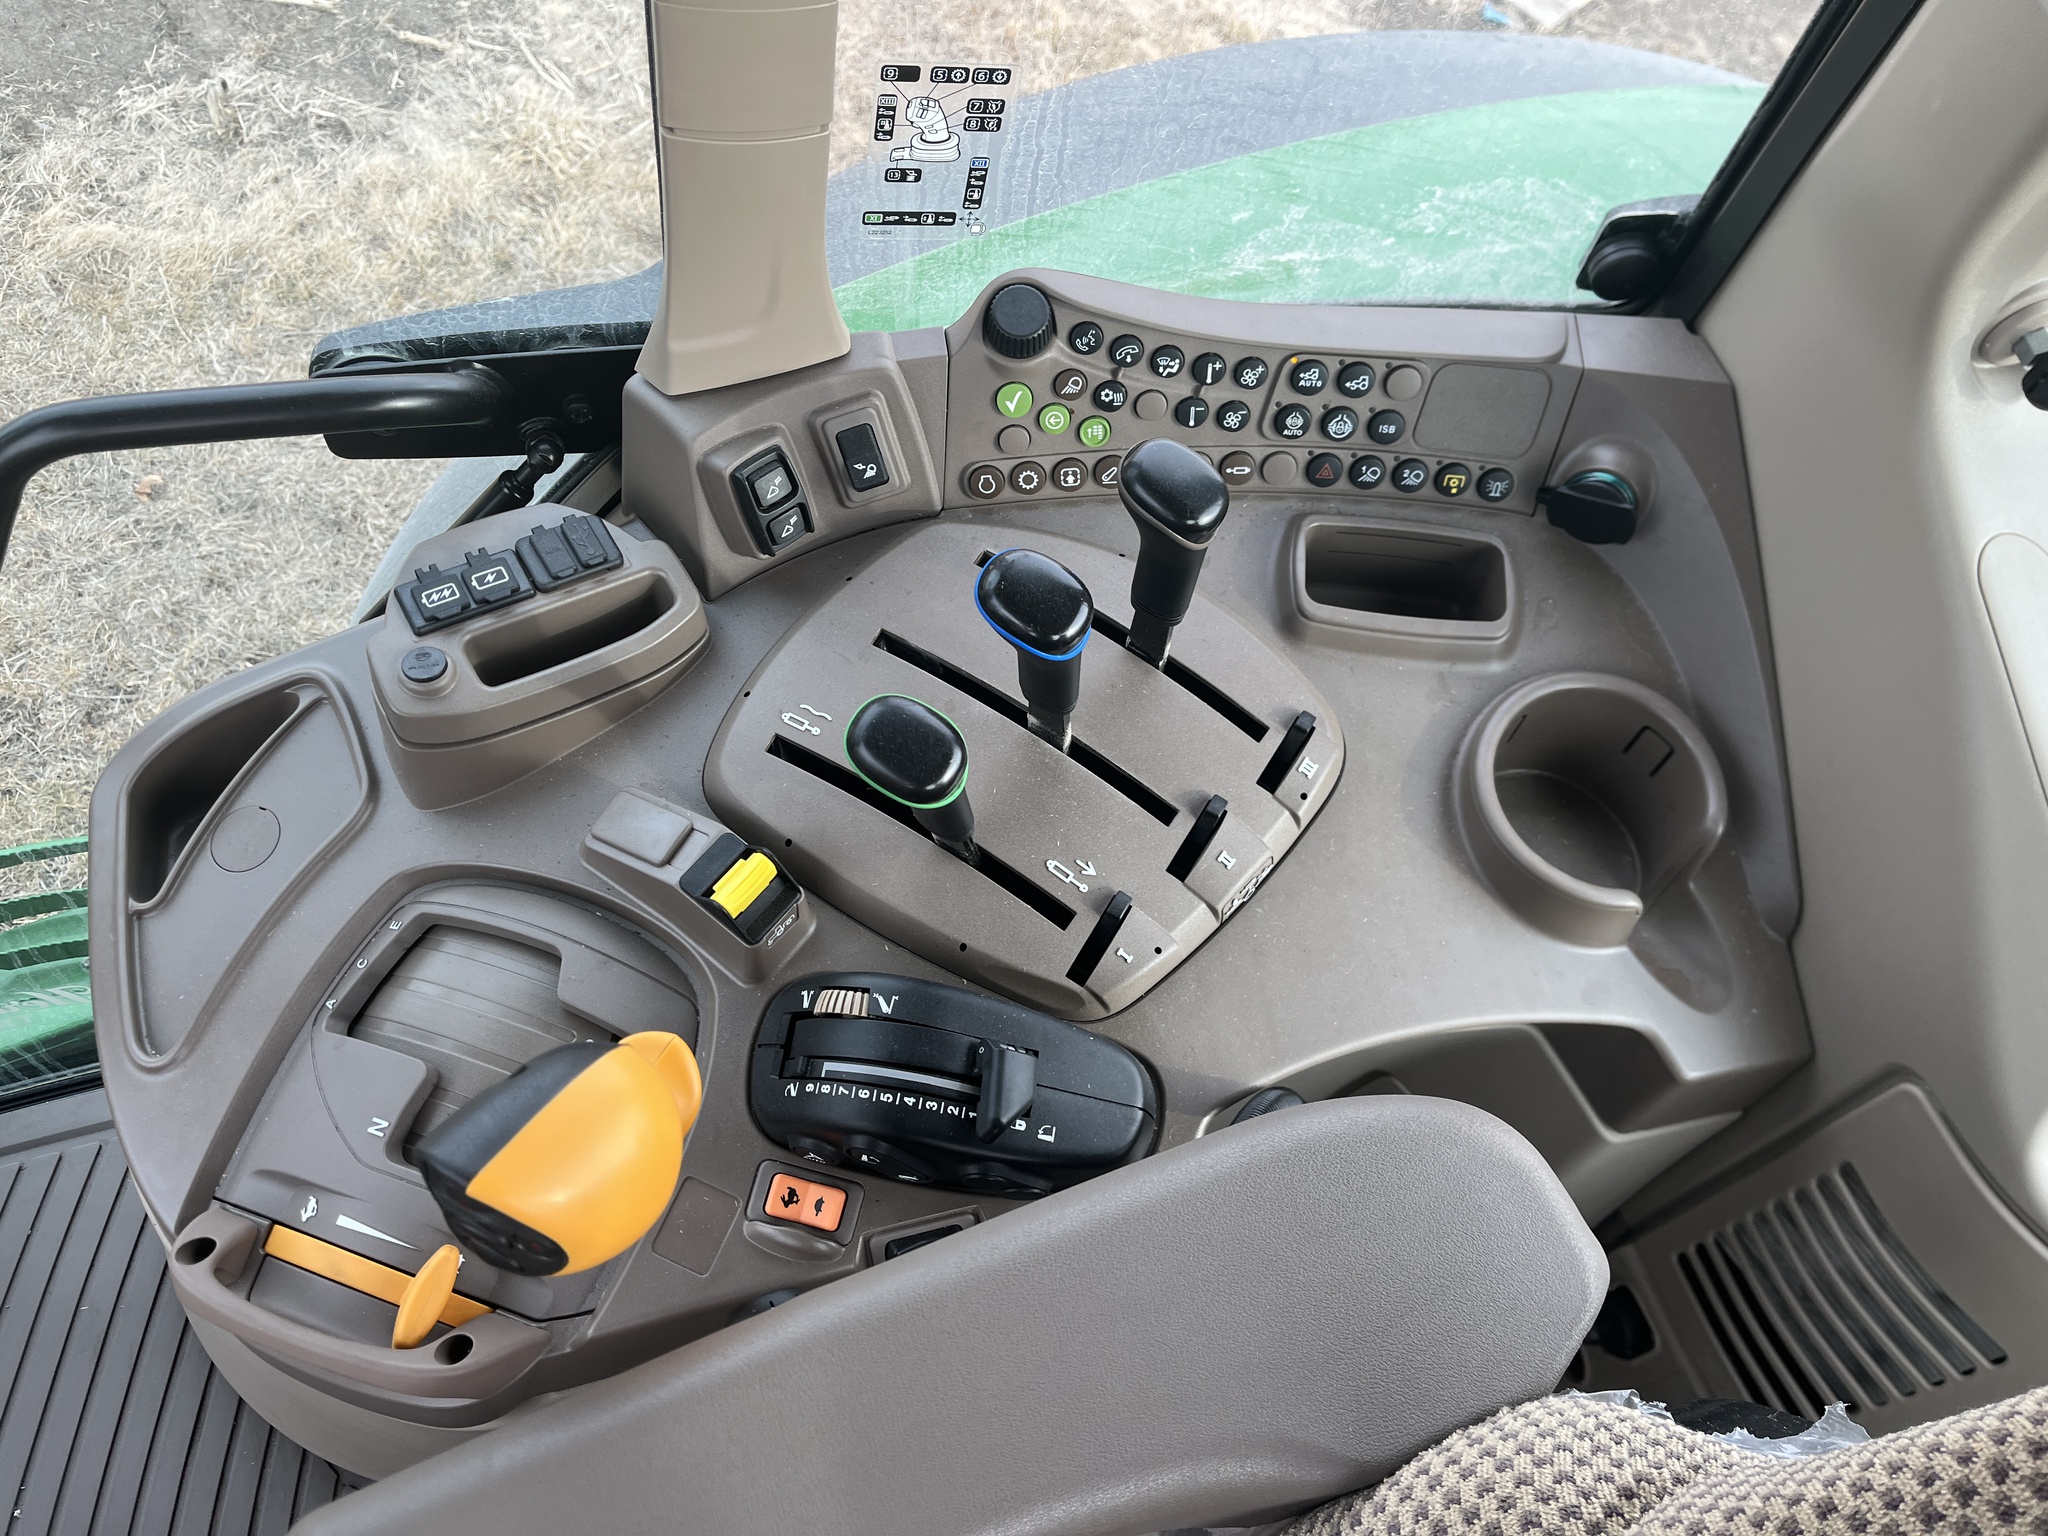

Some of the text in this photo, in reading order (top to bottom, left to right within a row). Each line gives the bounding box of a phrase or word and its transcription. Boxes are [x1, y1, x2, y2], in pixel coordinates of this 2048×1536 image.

[886, 69, 895, 79] 9
[936, 71, 944, 80] 5
[978, 72, 986, 81] 6
[973, 102, 980, 111] 7
[969, 119, 977, 128] 8
[1298, 380, 1323, 388] AUTO
[1378, 425, 1396, 434] ISB
[1361, 465, 1367, 474] 1
[1402, 469, 1410, 478] 2
[1298, 757, 1319, 779] III
[1216, 850, 1237, 870] II
[389, 920, 402, 931] E
[356, 958, 368, 970] C
[325, 998, 338, 1010] A
[805, 1085, 814, 1093] 9
[820, 1084, 831, 1094] 8
[838, 1086, 850, 1096] 7
[858, 1088, 870, 1099] 6
[879, 1092, 893, 1103] 5
[903, 1096, 917, 1107] 4
[925, 1100, 938, 1111] 3
[947, 1105, 960, 1116] 2
[366, 1117, 390, 1138] N
